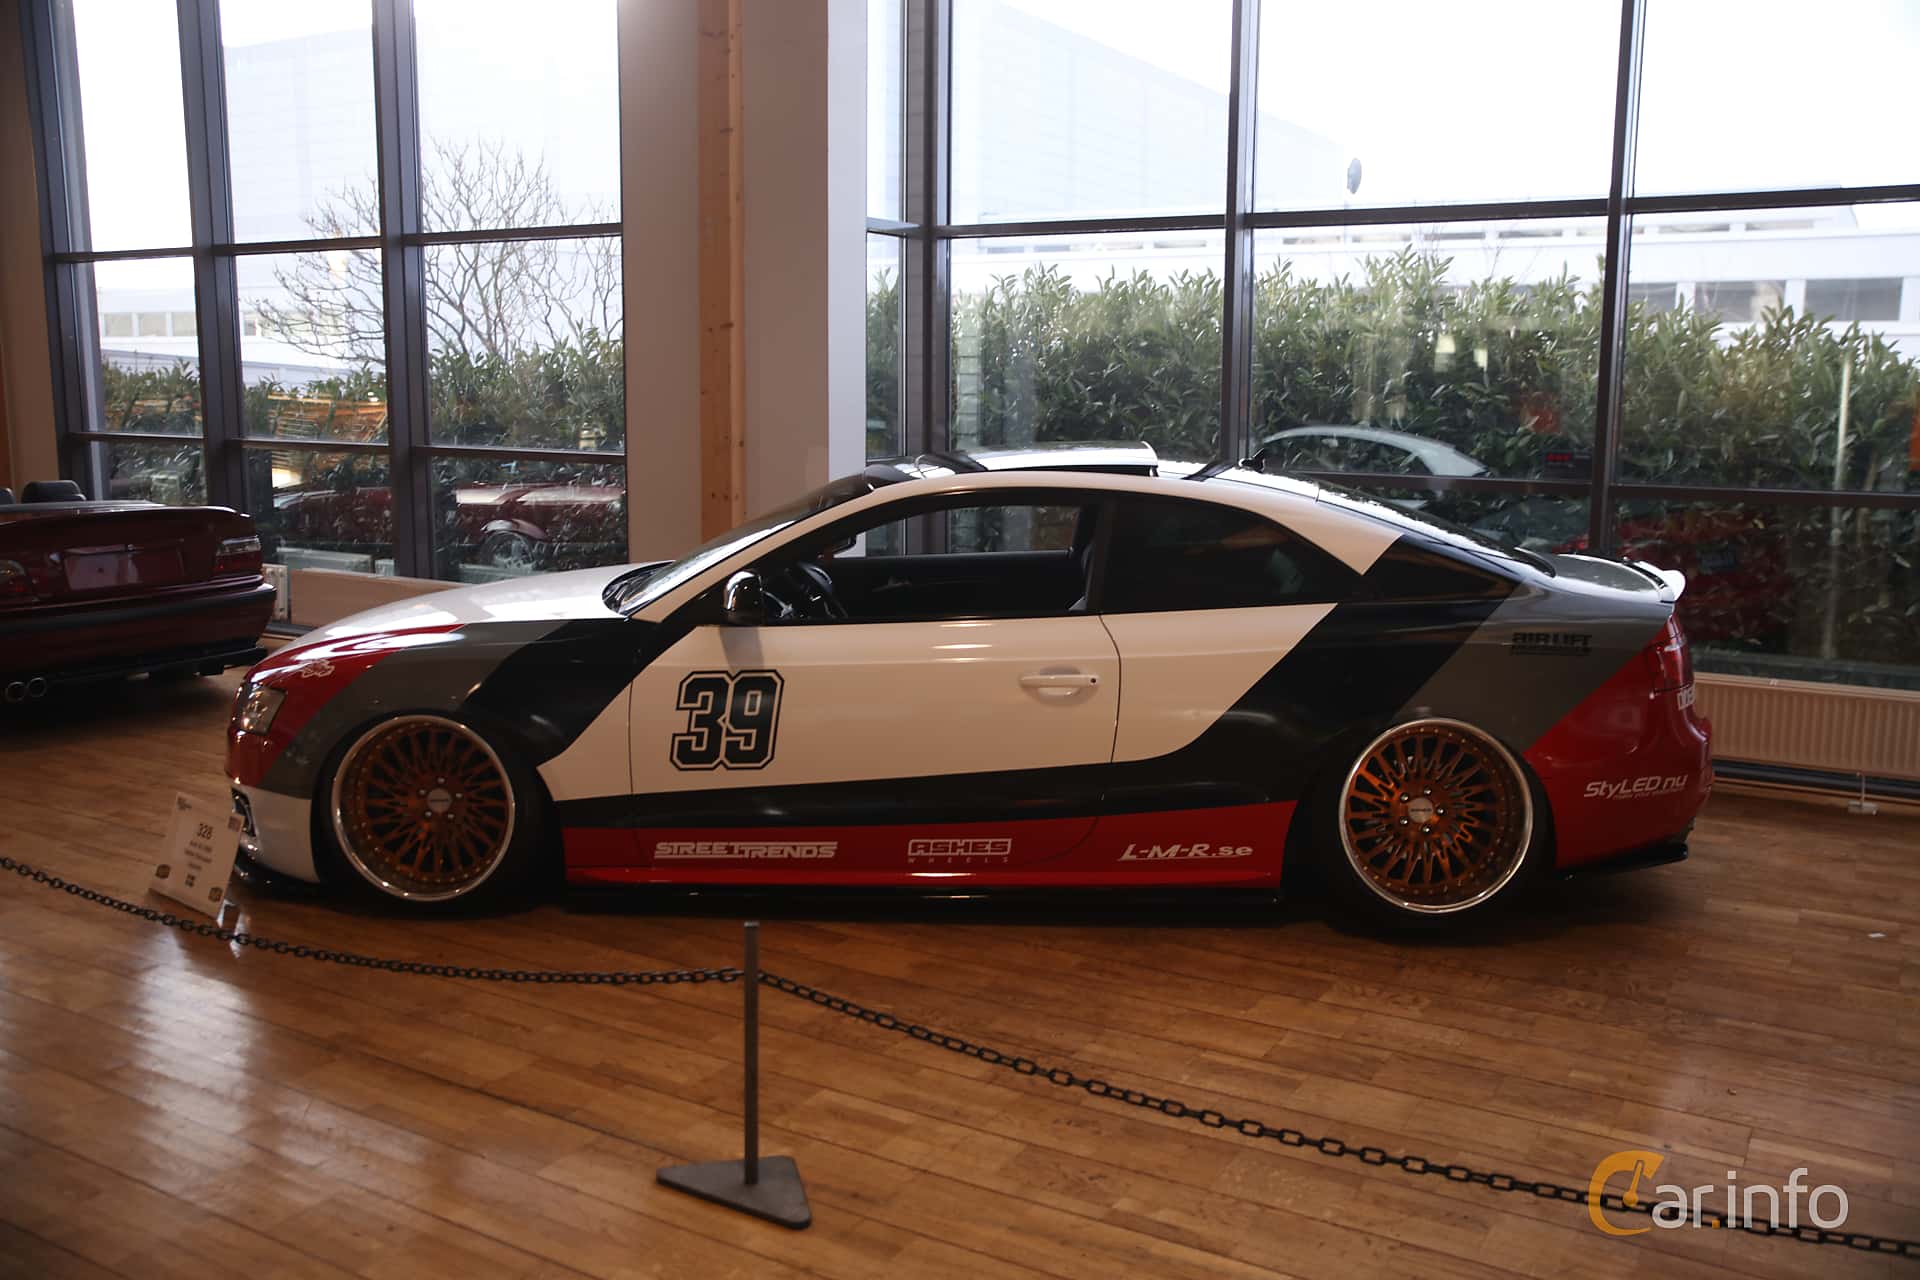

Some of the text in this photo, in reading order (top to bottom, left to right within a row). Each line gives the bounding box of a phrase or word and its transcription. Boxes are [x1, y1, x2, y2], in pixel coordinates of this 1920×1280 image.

[670, 669, 785, 771] 39
[907, 838, 1013, 856] ASHES
[1117, 843, 1254, 861] L-M-R.se
